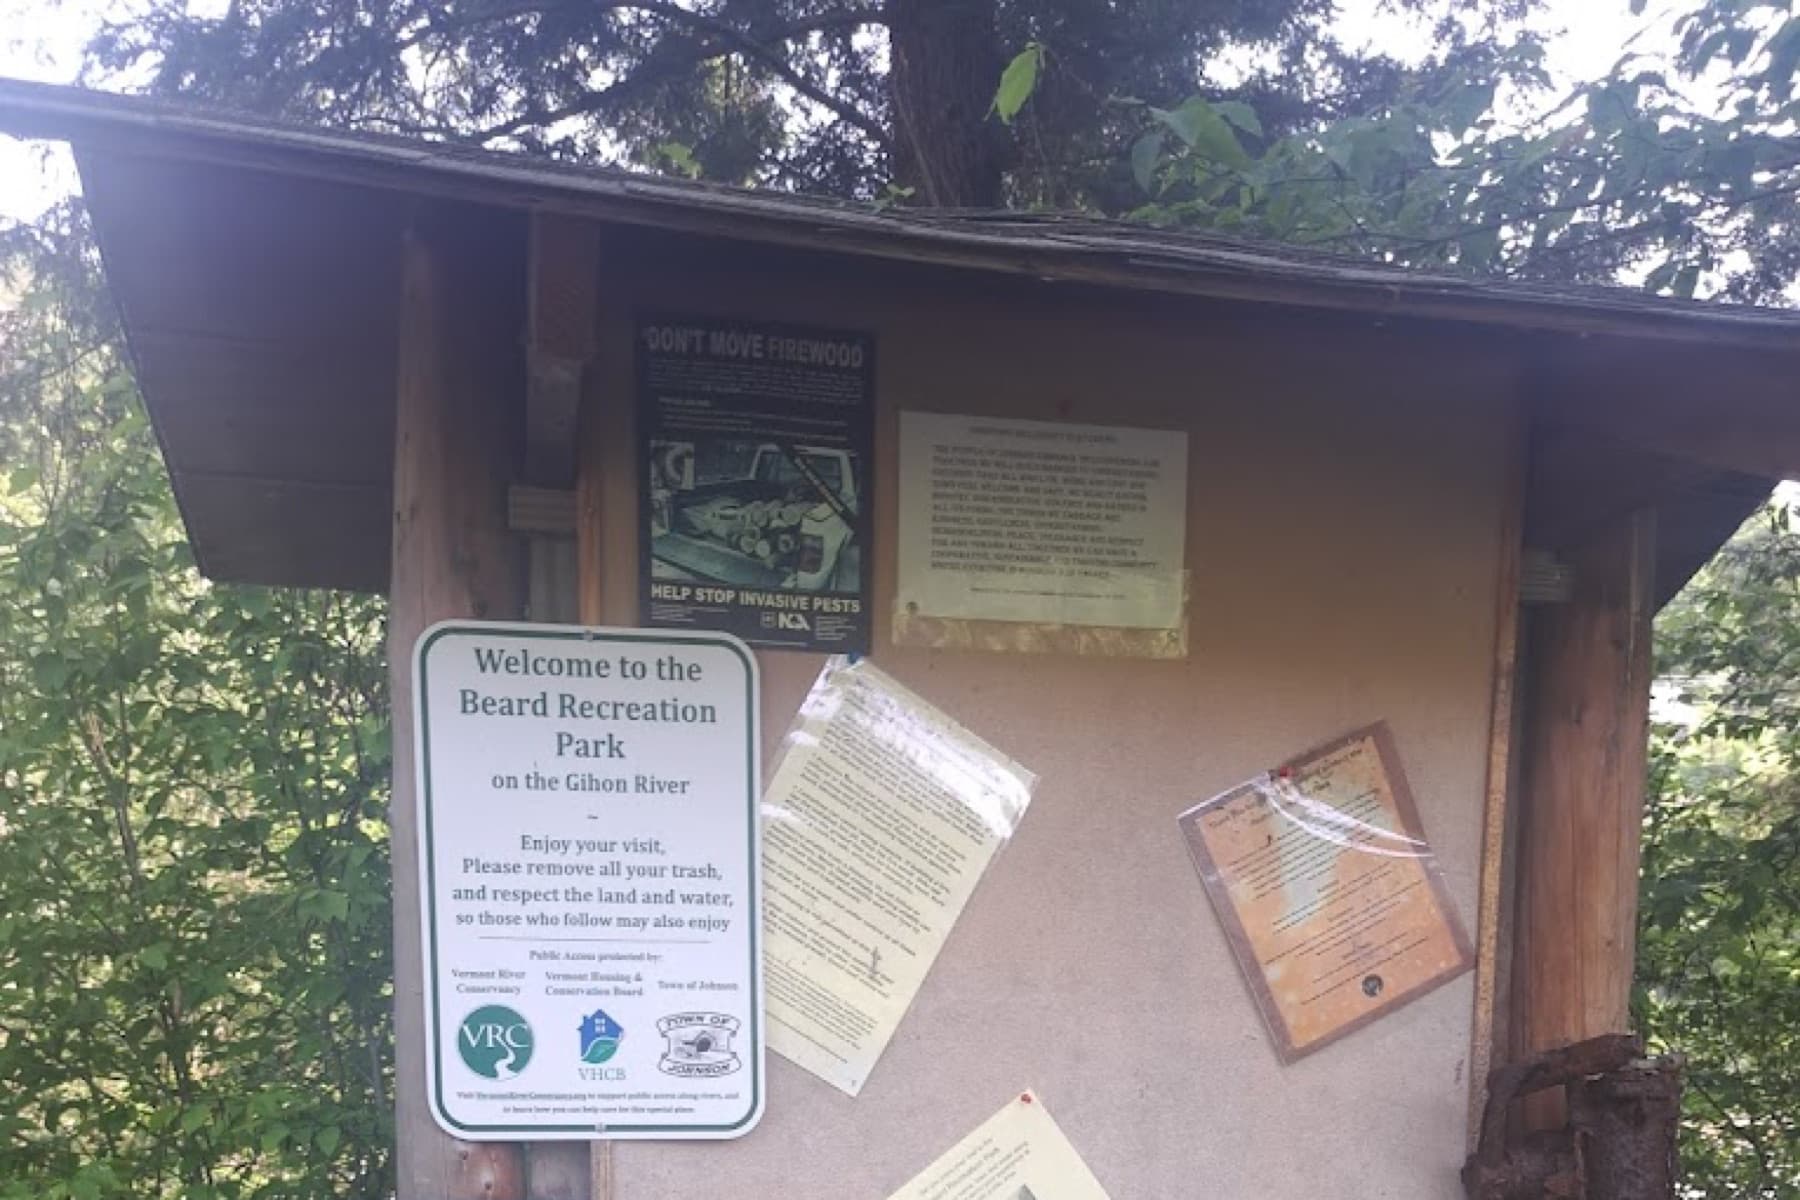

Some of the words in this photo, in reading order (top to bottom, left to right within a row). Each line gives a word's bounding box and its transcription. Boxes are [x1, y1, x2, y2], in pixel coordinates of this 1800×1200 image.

[709, 330, 764, 359] MOVE
[767, 336, 864, 368] FIREWOOD
[650, 584, 690, 601] HELP
[694, 588, 736, 605] STOP
[740, 590, 810, 612] INVASIVE
[812, 597, 861, 613] PESTS
[474, 647, 611, 678] Welcome
[620, 656, 648, 681] to
[656, 655, 703, 681] the
[459, 688, 549, 718] Beard
[558, 692, 718, 723] Recreation
[555, 731, 627, 759] Park
[491, 774, 519, 790] on
[525, 770, 559, 791] the
[566, 773, 628, 793] Gihon
[634, 774, 691, 794] River
[520, 834, 572, 856] Enjoy
[576, 839, 618, 856] your
[622, 836, 667, 855] visit,
[462, 857, 523, 876] Please
[527, 862, 596, 877] remove
[599, 859, 623, 877] all
[626, 864, 669, 882] your
[672, 862, 724, 881] trash,
[452, 885, 489, 902] and
[492, 888, 560, 908] respect
[564, 886, 594, 903] the
[598, 887, 638, 905] land
[641, 889, 675, 905] and
[679, 891, 735, 908] water,
[456, 913, 474, 926] so
[478, 910, 523, 926] those
[526, 912, 560, 927] who
[563, 911, 613, 928] follow
[616, 915, 649, 932] may
[653, 913, 686, 929] also
[689, 915, 731, 933] enjoy
[528, 950, 561, 962] Public
[564, 951, 596, 962] Access
[451, 968, 496, 979] Vermont
[497, 968, 527, 980] River
[545, 970, 589, 982] Vermont
[590, 971, 632, 984] Housing
[657, 979, 684, 991] Town
[686, 980, 698, 991] of
[699, 980, 739, 992] Johnson
[455, 983, 523, 996] Conservancy
[544, 985, 612, 997] Conservation
[614, 986, 644, 997] Board
[710, 1015, 731, 1025] OF
[460, 1022, 529, 1049] VRC
[577, 1067, 627, 1082] VHCB
